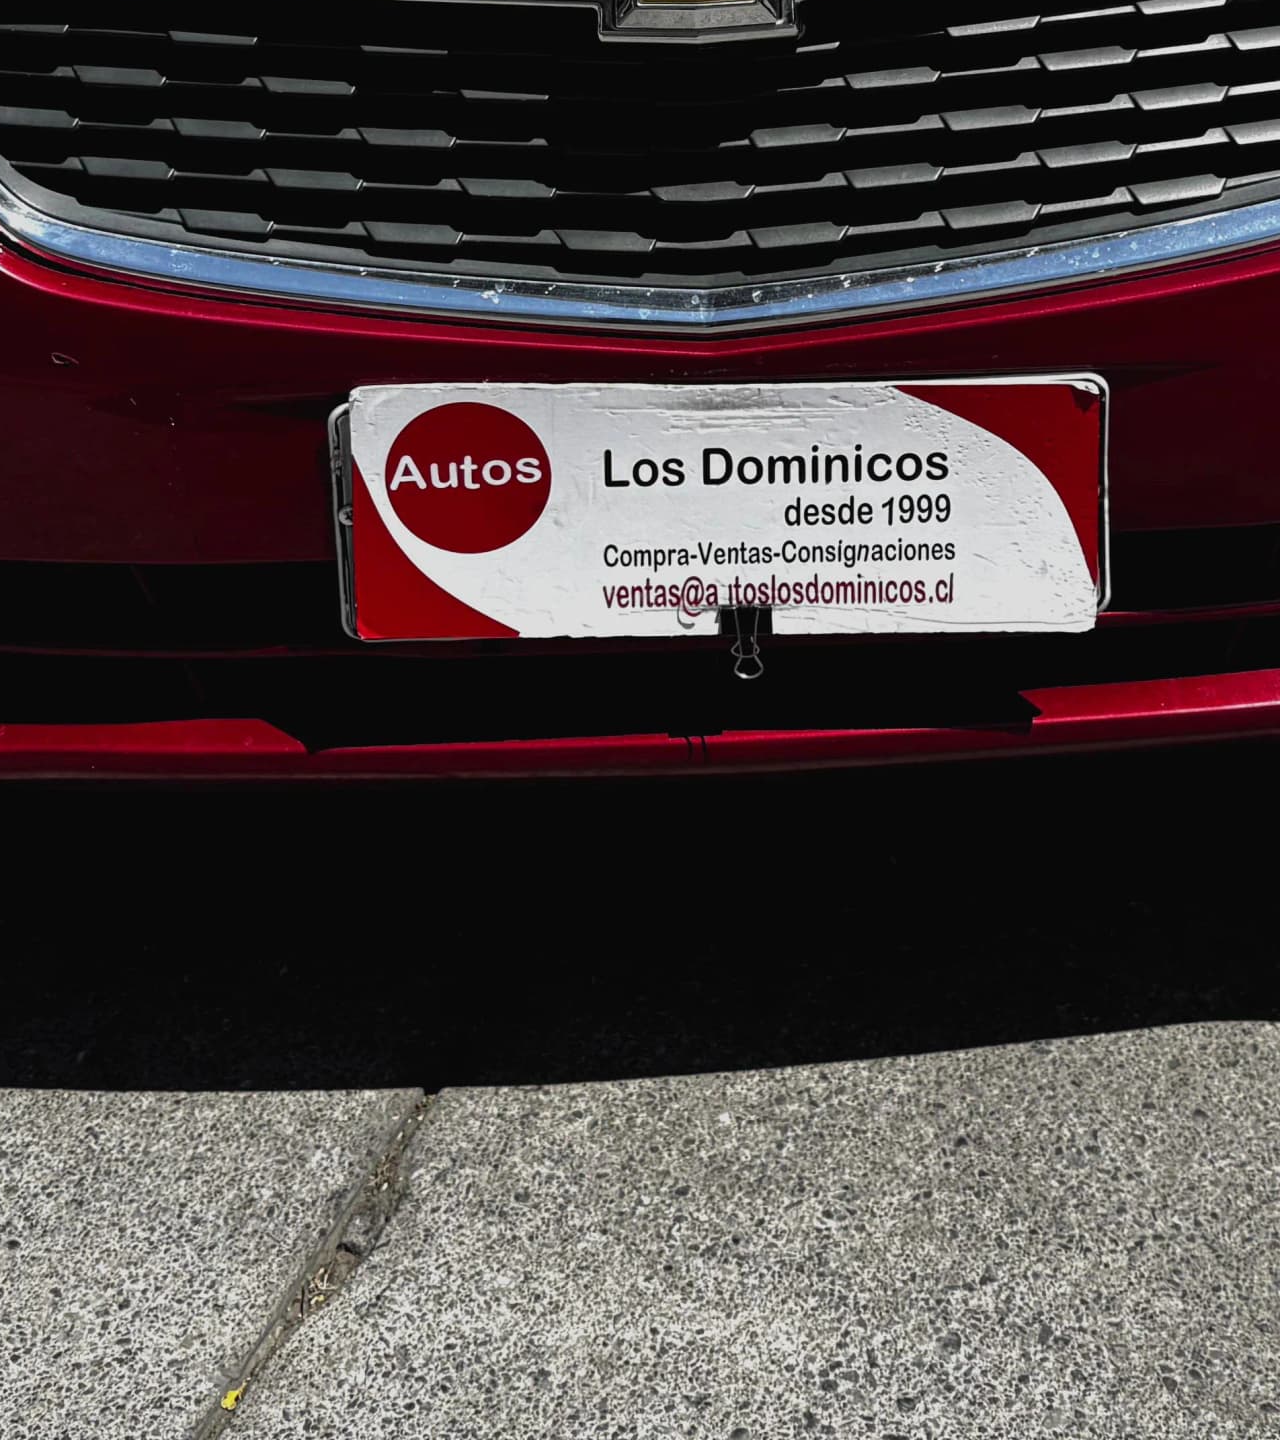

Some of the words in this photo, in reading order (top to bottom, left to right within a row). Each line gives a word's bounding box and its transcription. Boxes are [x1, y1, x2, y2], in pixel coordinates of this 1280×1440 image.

[390, 455, 542, 491] Autos
[604, 449, 686, 487] Los
[702, 444, 950, 486] Dominicos
[784, 495, 873, 527] desde
[881, 493, 952, 526] 1999
[603, 538, 956, 572] Compra-Ventas-Consignaciones
